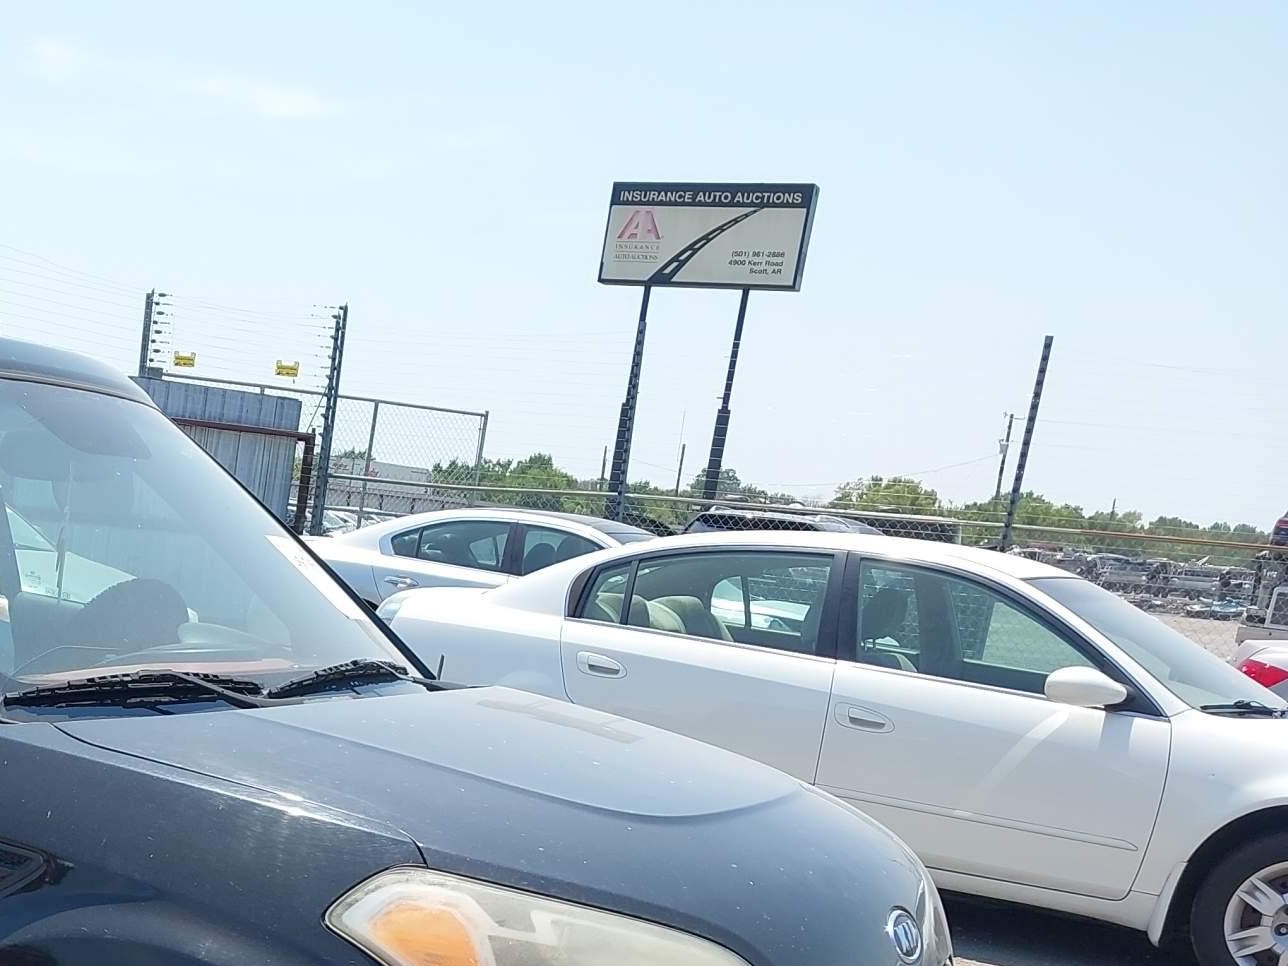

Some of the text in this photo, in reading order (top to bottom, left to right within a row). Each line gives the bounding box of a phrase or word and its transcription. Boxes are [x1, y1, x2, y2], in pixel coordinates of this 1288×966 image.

[620, 190, 802, 204] INSURANCE AUTO AUCTIONS
